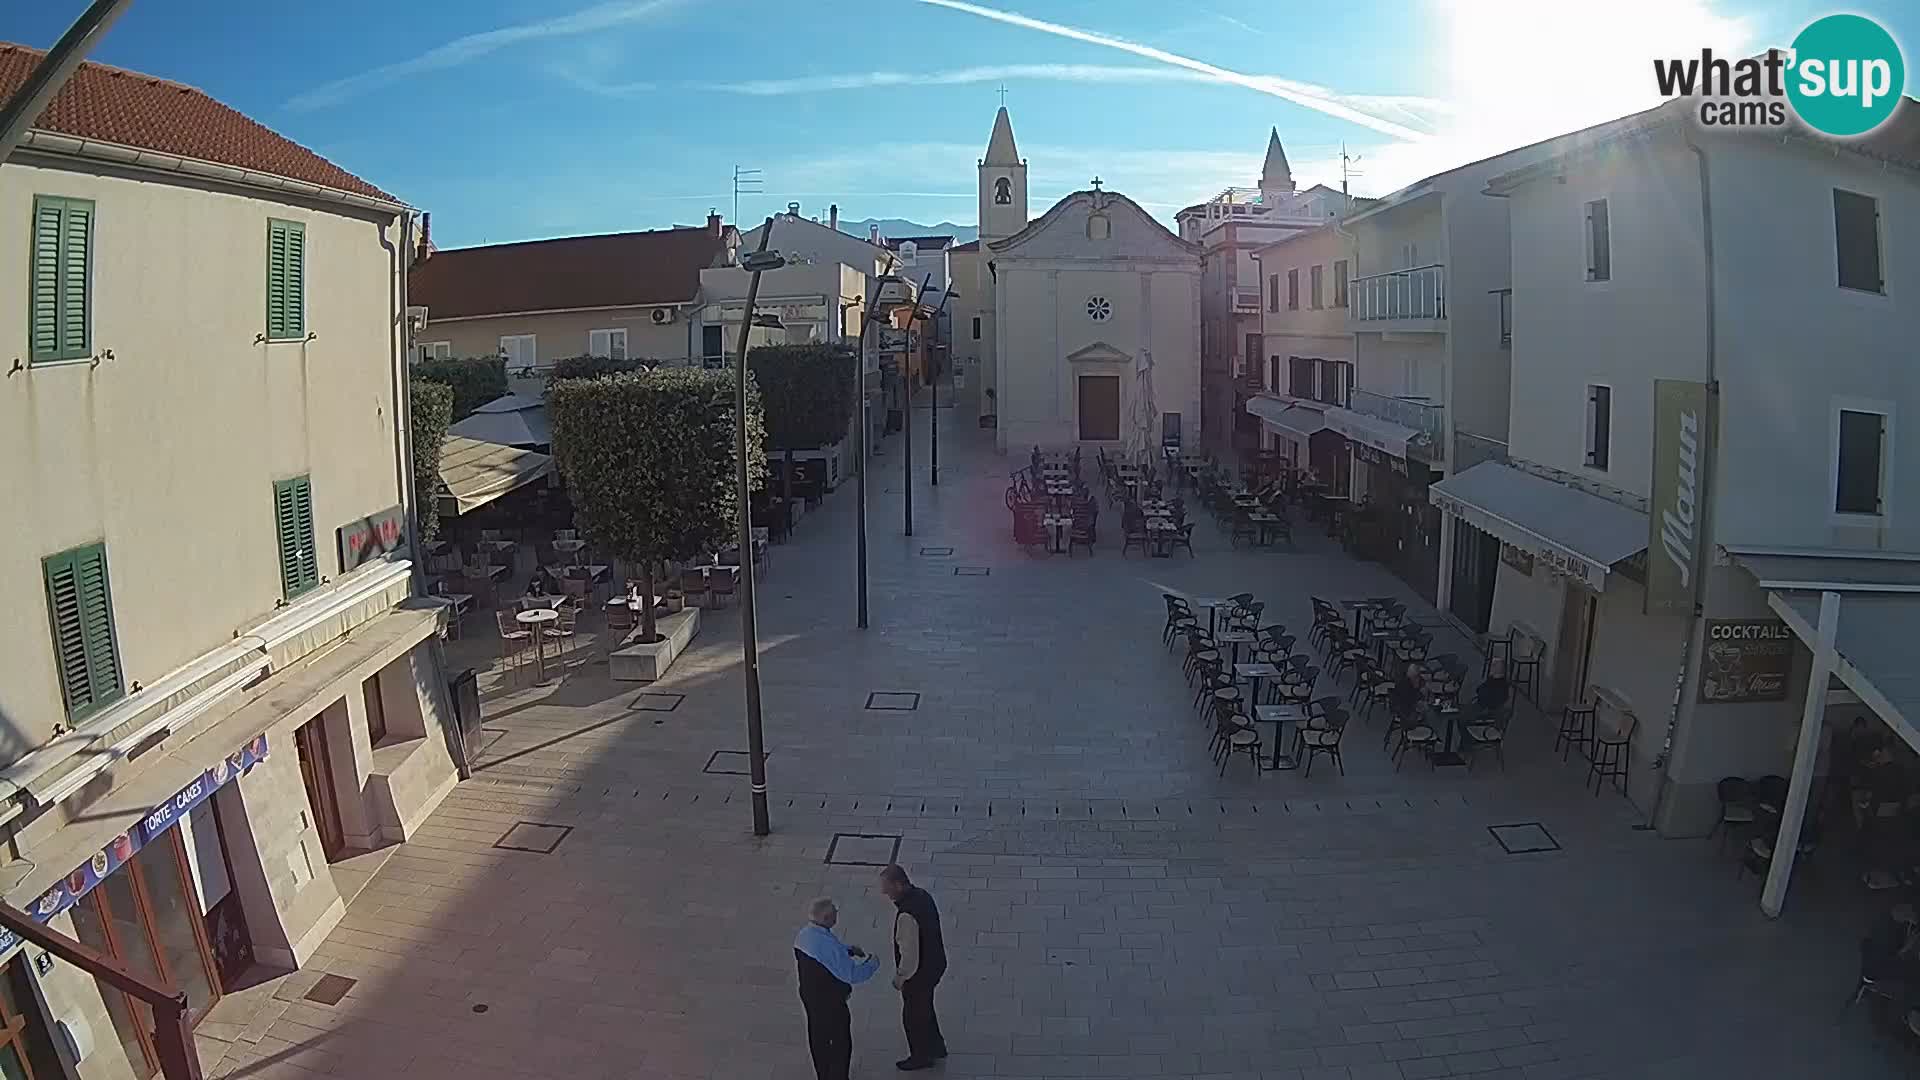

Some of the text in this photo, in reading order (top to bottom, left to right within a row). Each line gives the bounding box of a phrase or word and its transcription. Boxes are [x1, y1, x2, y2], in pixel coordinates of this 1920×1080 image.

[1710, 625, 1791, 639] COCKTAILS
[143, 780, 203, 835] TORTE CAKES
